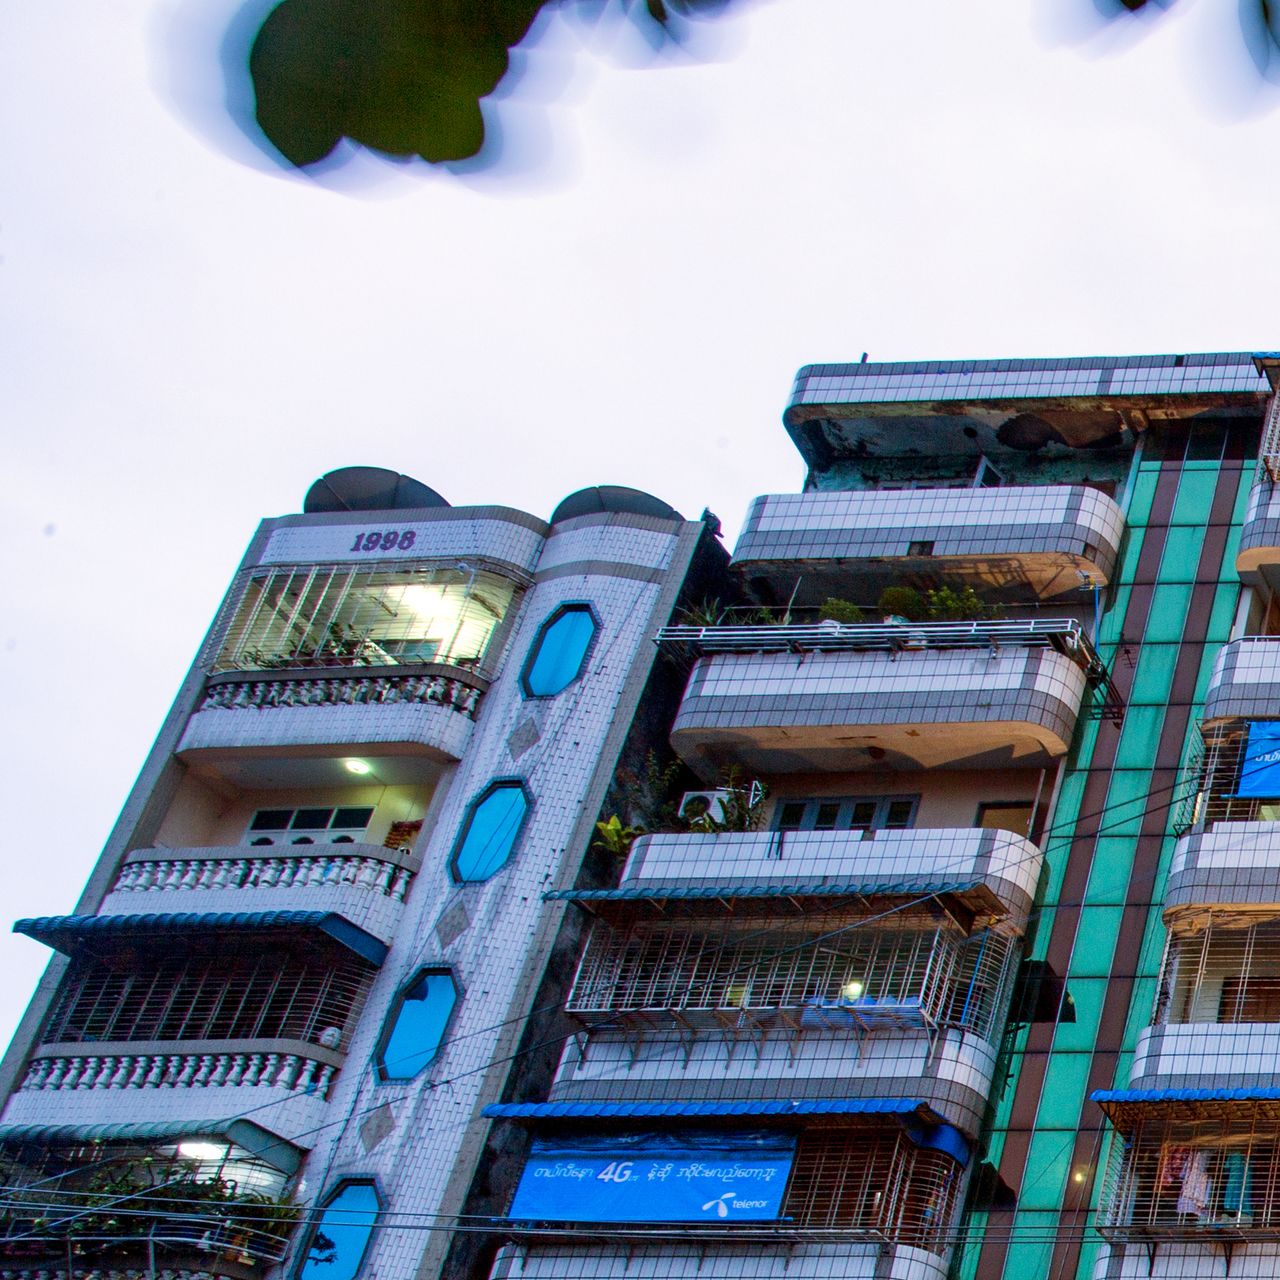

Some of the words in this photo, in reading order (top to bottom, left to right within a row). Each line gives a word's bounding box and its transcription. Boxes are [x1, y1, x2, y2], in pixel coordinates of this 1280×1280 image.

[351, 529, 416, 552] 1998
[597, 1161, 634, 1182] 4G
[732, 1199, 767, 1209] telenor
